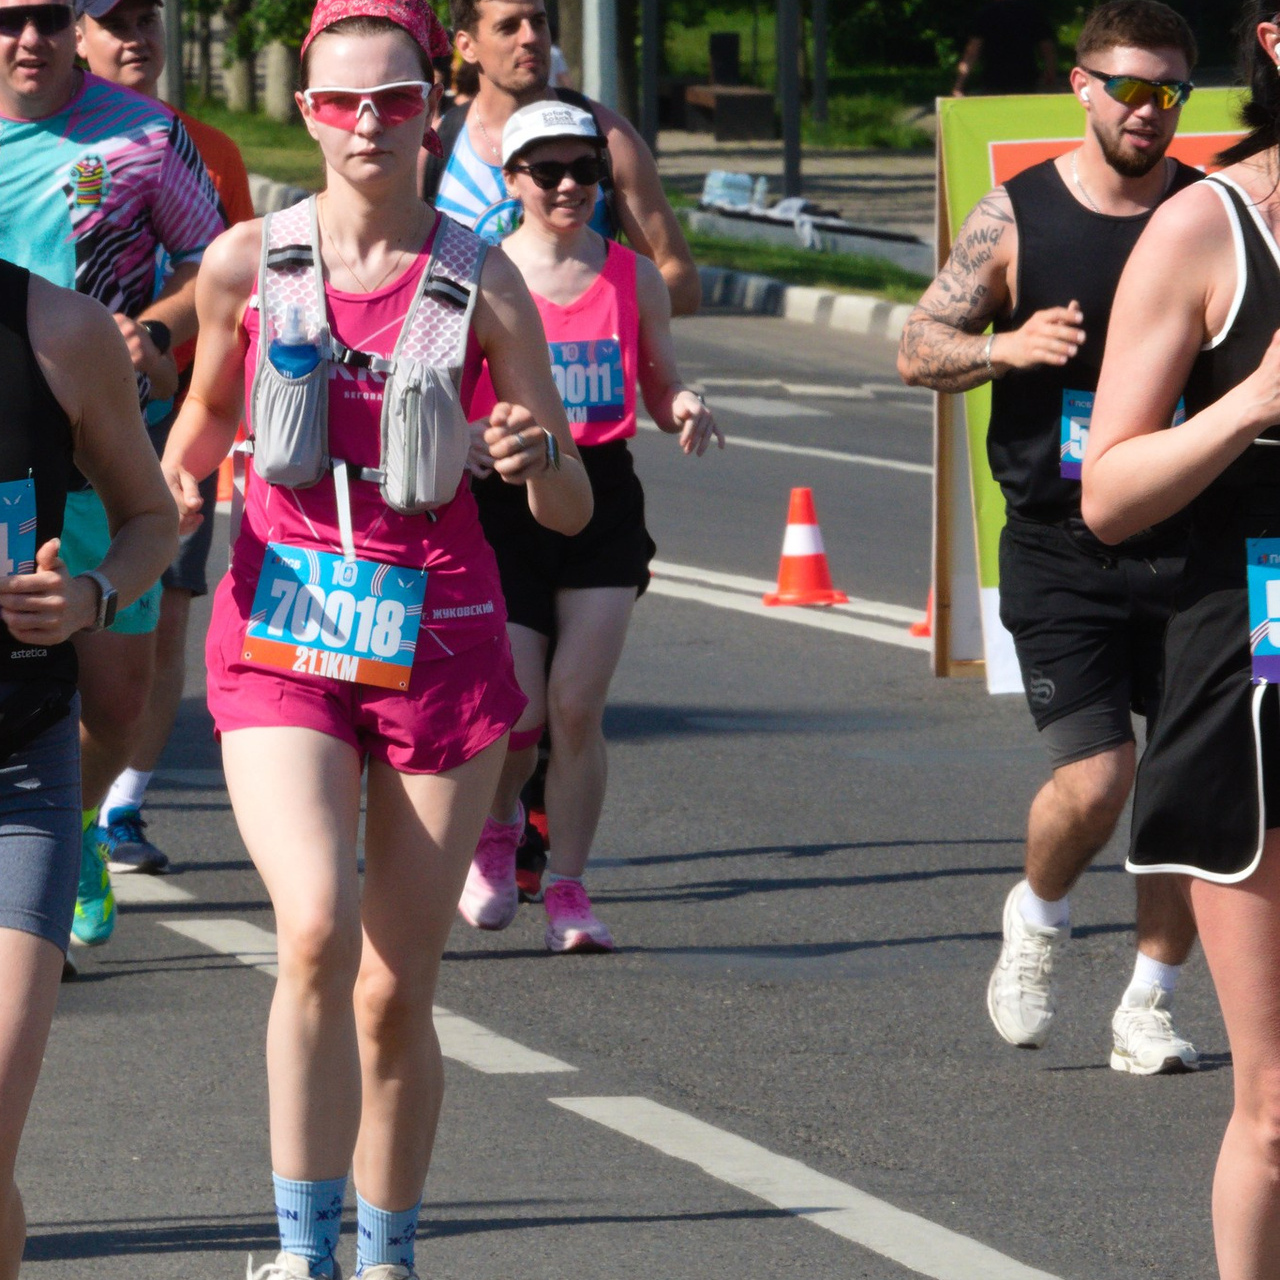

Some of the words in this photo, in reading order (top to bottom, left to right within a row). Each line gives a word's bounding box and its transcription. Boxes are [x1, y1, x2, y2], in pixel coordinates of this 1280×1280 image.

[266, 578, 406, 658] 70018
[431, 599, 494, 620] ЖУКОВСКИЙ
[10, 647, 48, 659] astetica
[291, 645, 360, 683] 21.1KM
